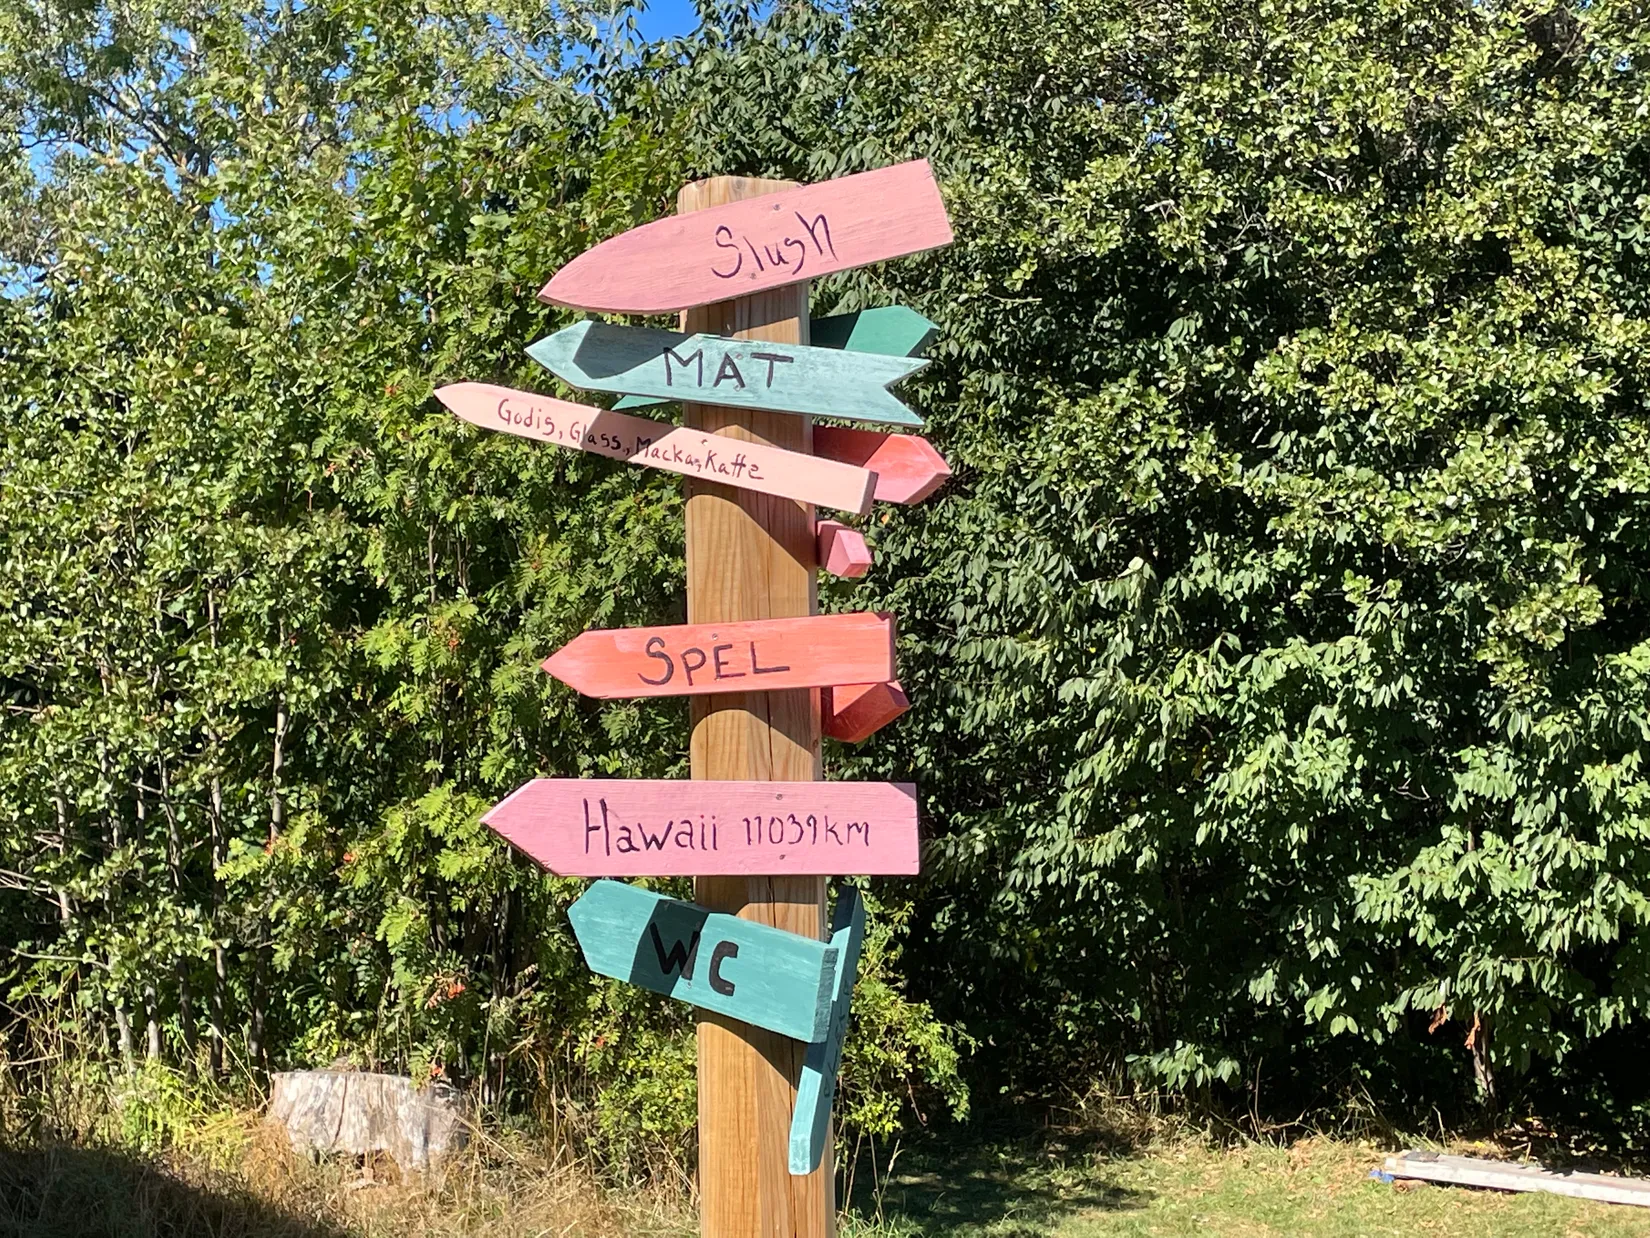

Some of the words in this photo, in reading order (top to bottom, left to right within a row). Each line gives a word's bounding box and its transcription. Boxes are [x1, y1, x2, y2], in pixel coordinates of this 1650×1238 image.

[711, 211, 839, 279] Slush
[663, 347, 795, 388] MAT
[637, 636, 791, 687] SPEL
[582, 798, 719, 857] Hawaii
[648, 921, 740, 997] WC
